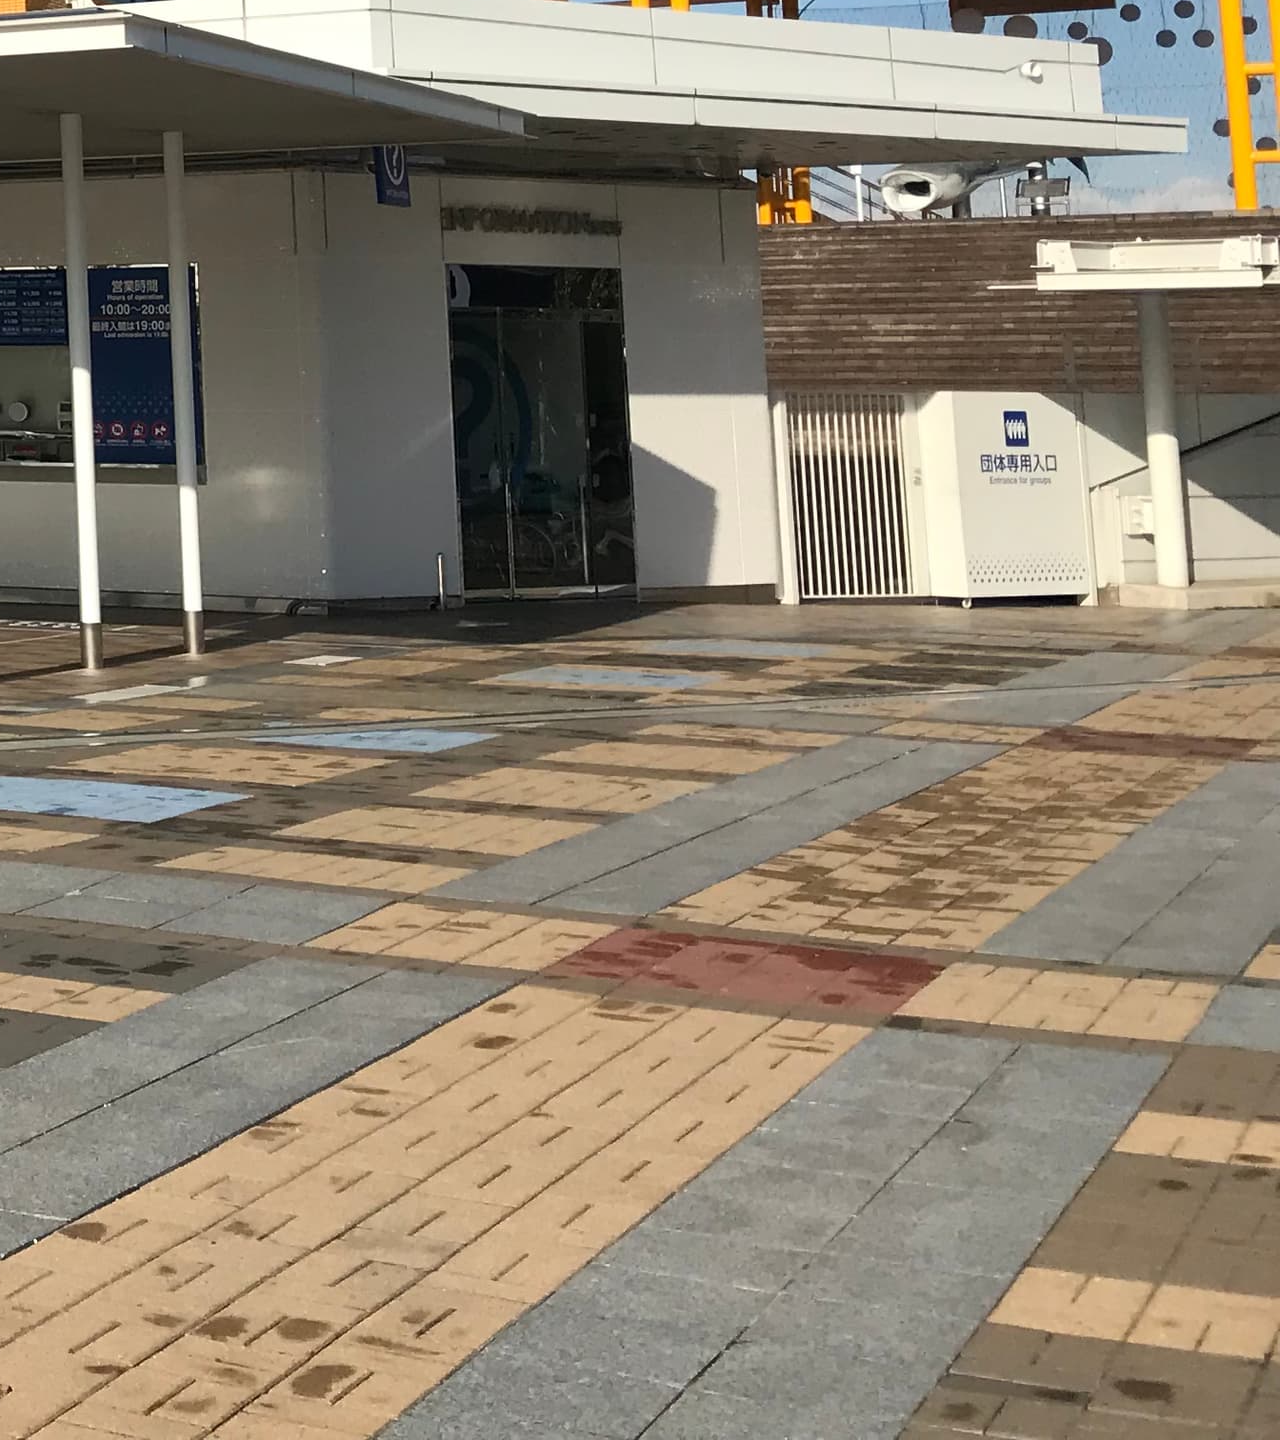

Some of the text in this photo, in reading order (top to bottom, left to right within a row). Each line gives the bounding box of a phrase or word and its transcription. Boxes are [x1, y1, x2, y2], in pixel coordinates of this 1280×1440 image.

[980, 454, 1057, 473] 団体専用入口
[989, 476, 1052, 486] Entrance for groups
